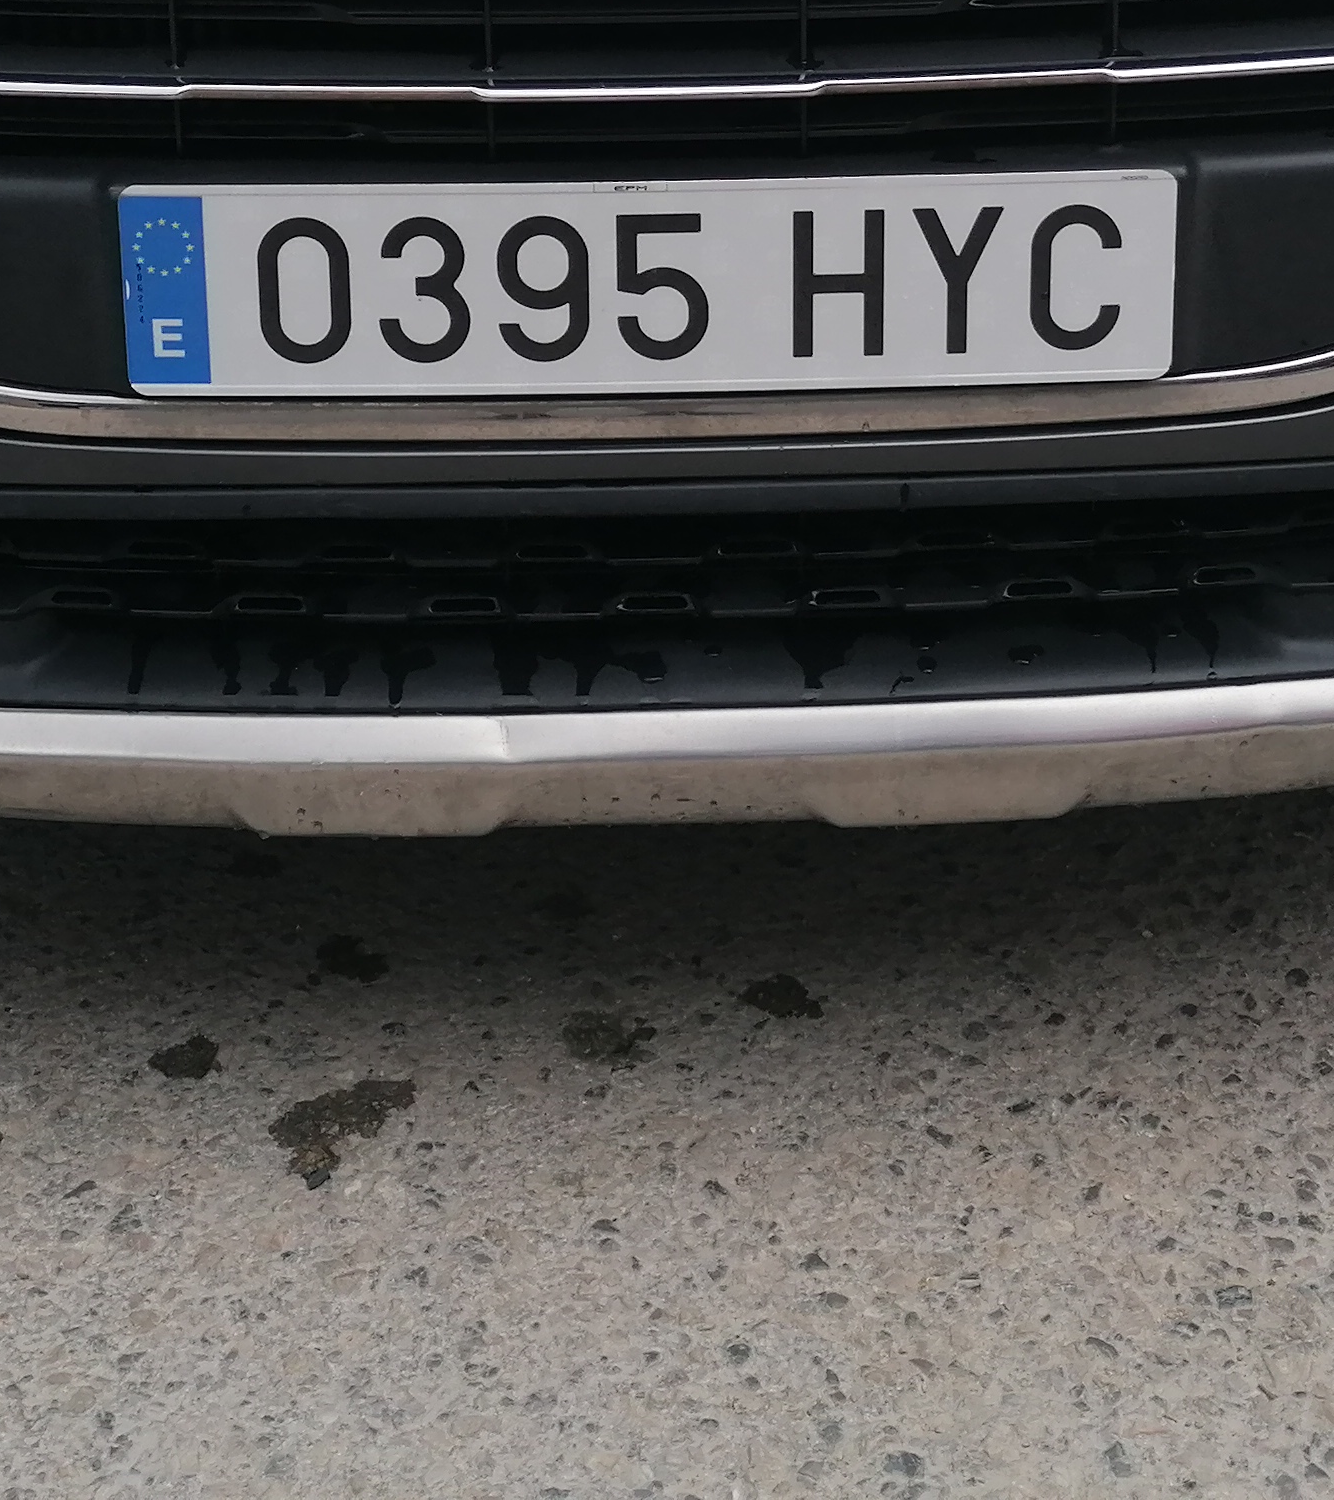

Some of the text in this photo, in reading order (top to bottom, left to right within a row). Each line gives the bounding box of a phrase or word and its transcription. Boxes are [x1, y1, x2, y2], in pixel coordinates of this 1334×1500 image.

[257, 204, 1123, 364] 0395 HYC
[151, 318, 186, 358] E
